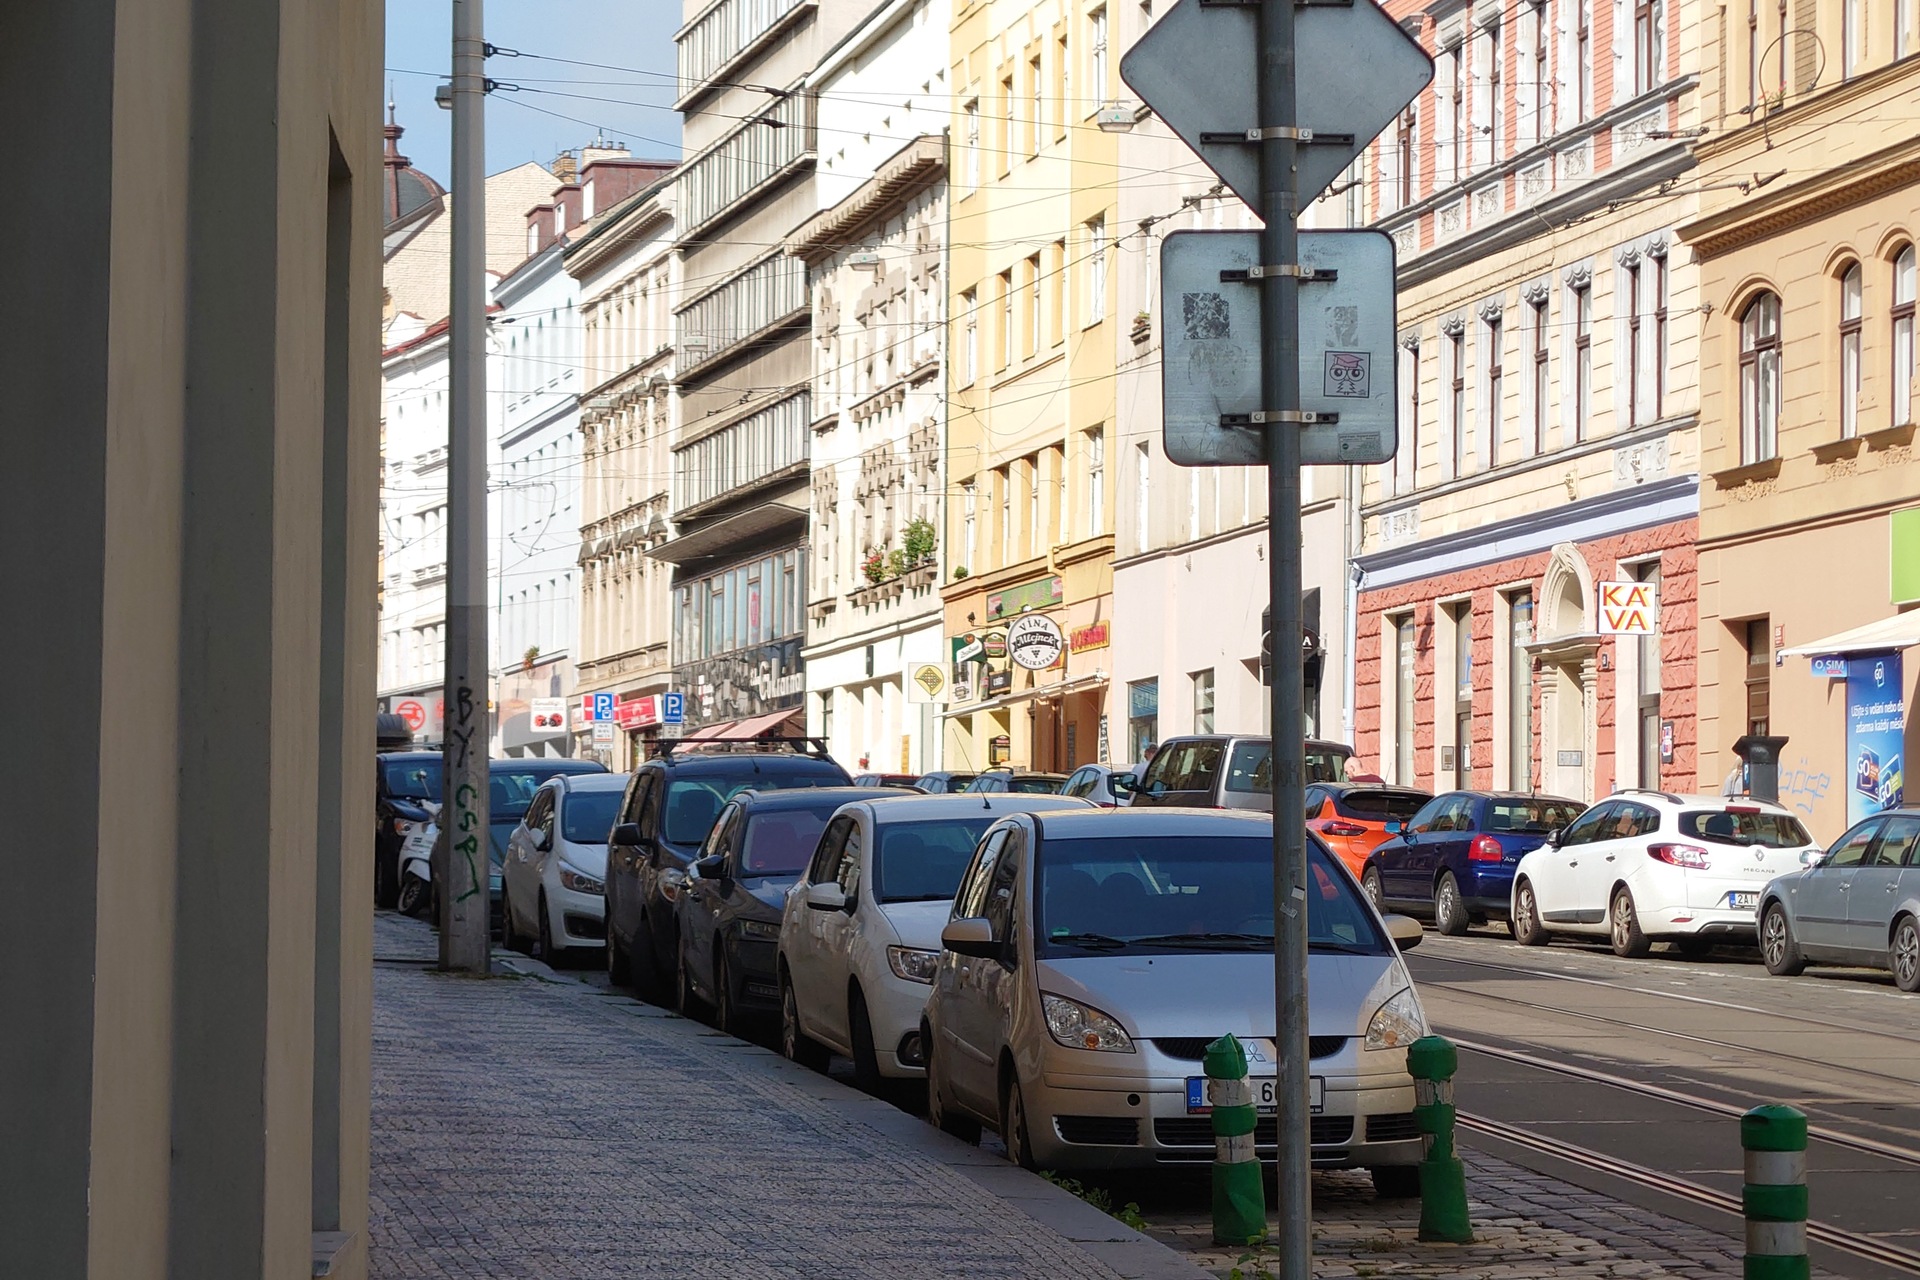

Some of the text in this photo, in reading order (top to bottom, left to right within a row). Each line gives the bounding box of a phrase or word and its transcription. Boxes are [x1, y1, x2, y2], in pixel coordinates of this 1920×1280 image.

[1604, 609, 1649, 631] VA
[1826, 660, 1845, 670] SIM
[597, 696, 609, 713] P
[667, 696, 679, 714] P
[1885, 700, 1897, 713] nebo
[1857, 757, 1870, 777] GO
[1879, 780, 1892, 803] GO
